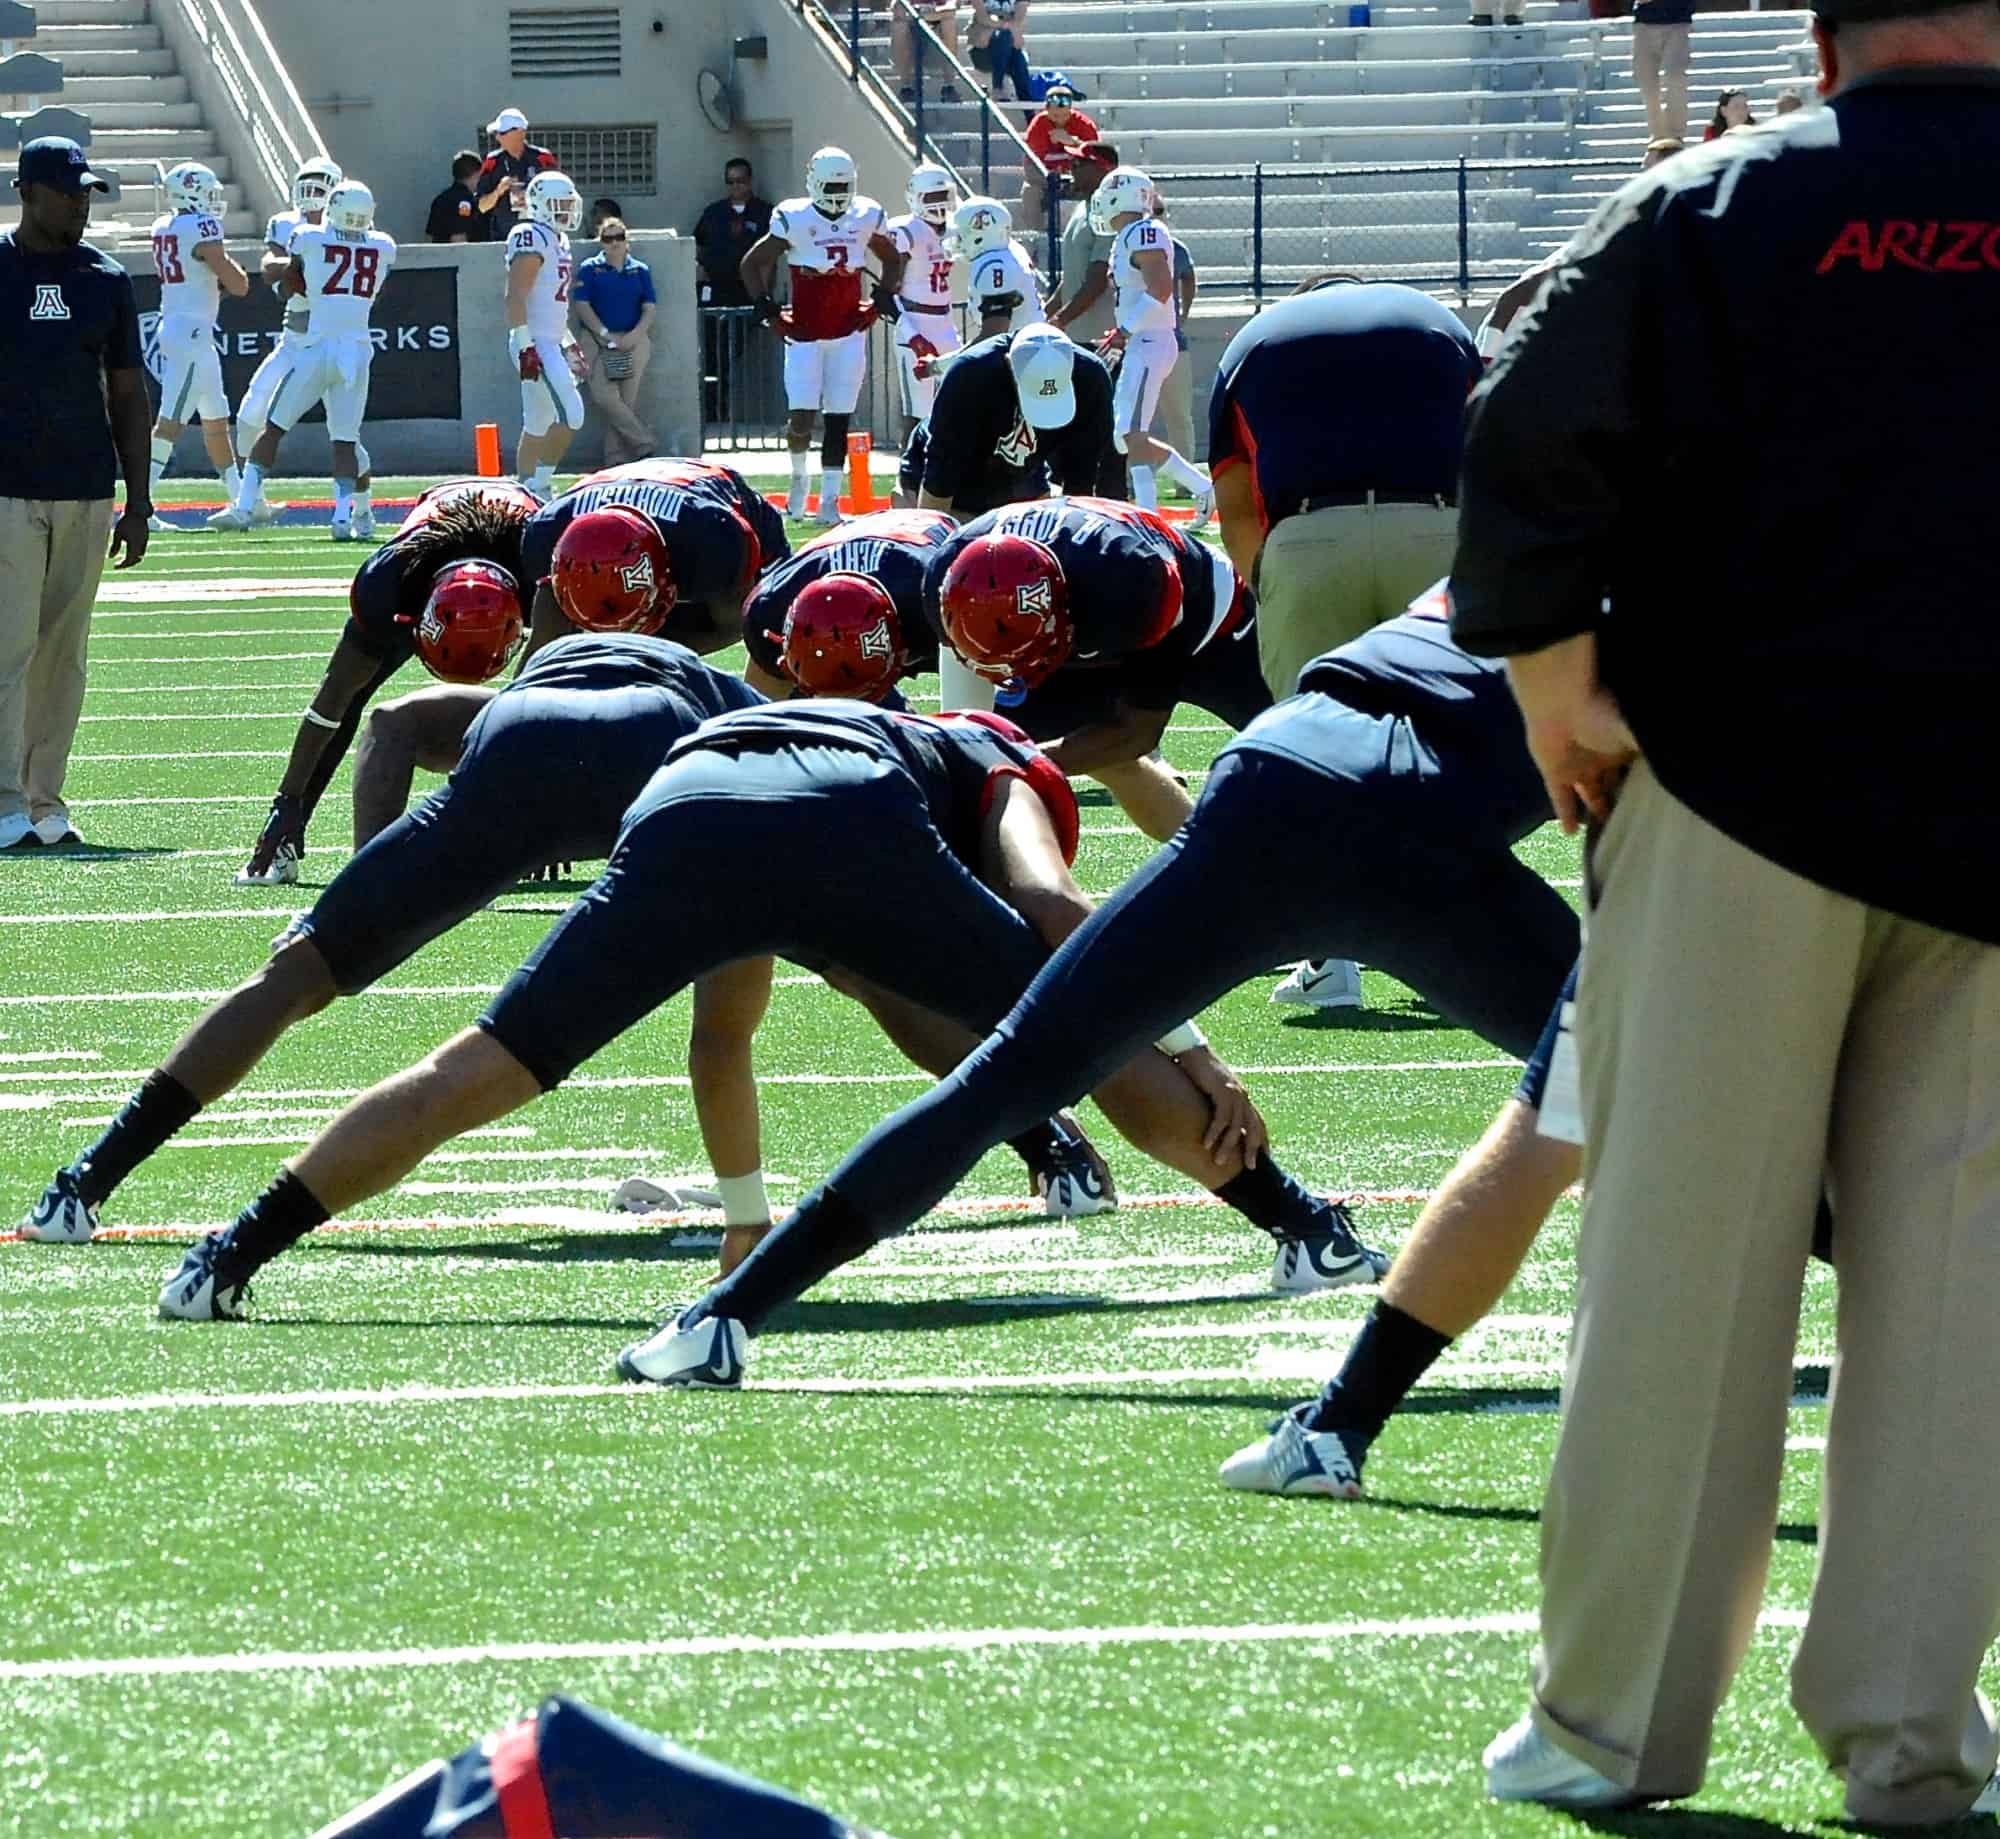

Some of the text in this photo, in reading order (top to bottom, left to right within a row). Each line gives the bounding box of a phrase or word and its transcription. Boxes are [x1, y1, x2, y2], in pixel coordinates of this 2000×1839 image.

[197, 220, 218, 238] 33
[321, 244, 379, 298] 28
[30, 284, 72, 320] A
[1039, 378, 1059, 396] A
[619, 551, 655, 593] A
[1016, 576, 1052, 616] A
[859, 616, 891, 660] A
